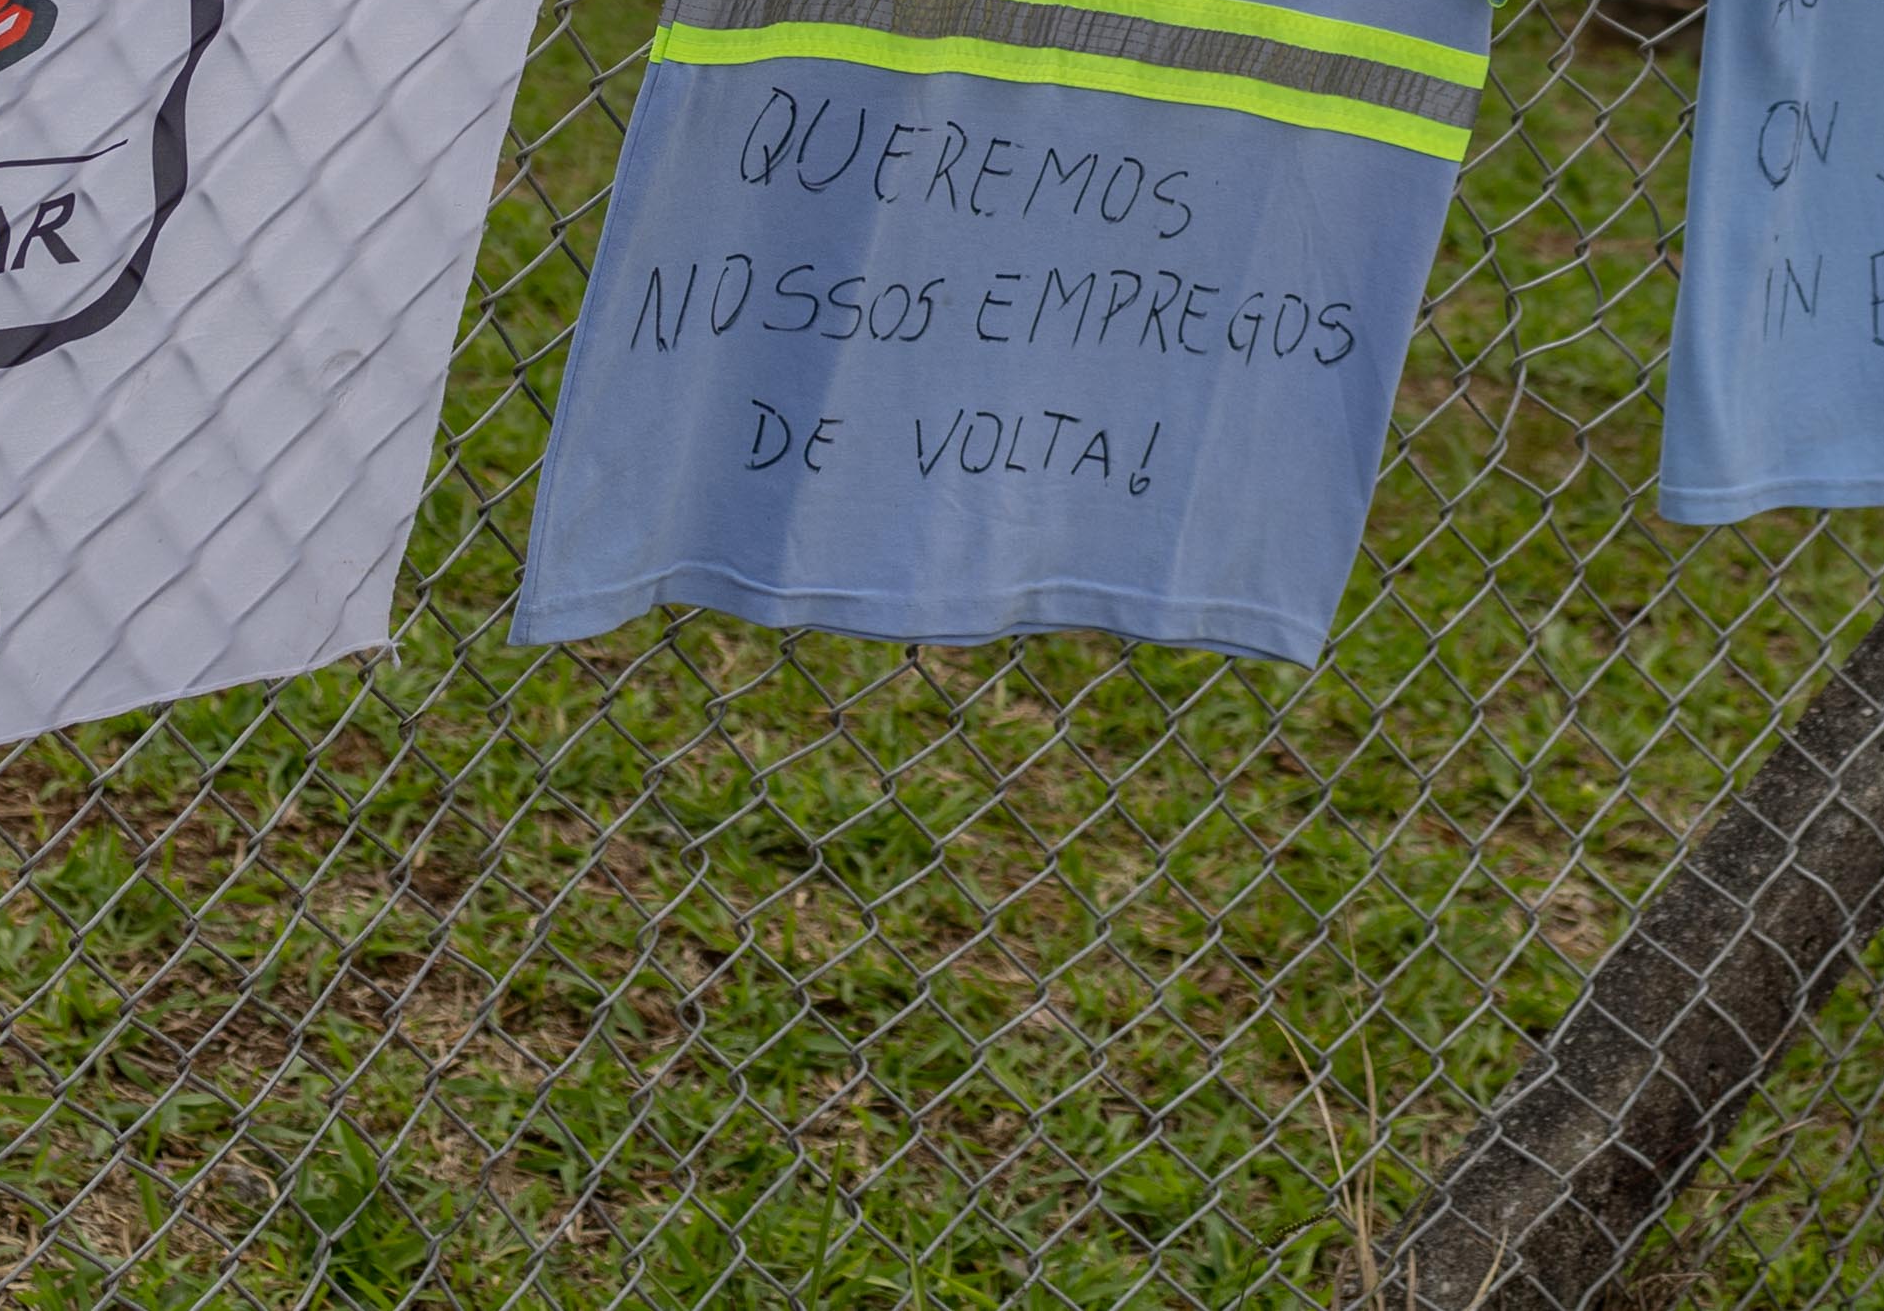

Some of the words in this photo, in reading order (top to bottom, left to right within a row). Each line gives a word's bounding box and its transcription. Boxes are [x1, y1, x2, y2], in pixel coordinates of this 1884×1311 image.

[739, 86, 1193, 239] QUEREMOS
[1756, 98, 1839, 191] ON
[631, 253, 946, 352] NOSSOS
[976, 268, 1358, 368] EMPREGOS
[745, 399, 845, 474] DE
[915, 408, 1163, 497] VOLTA!
